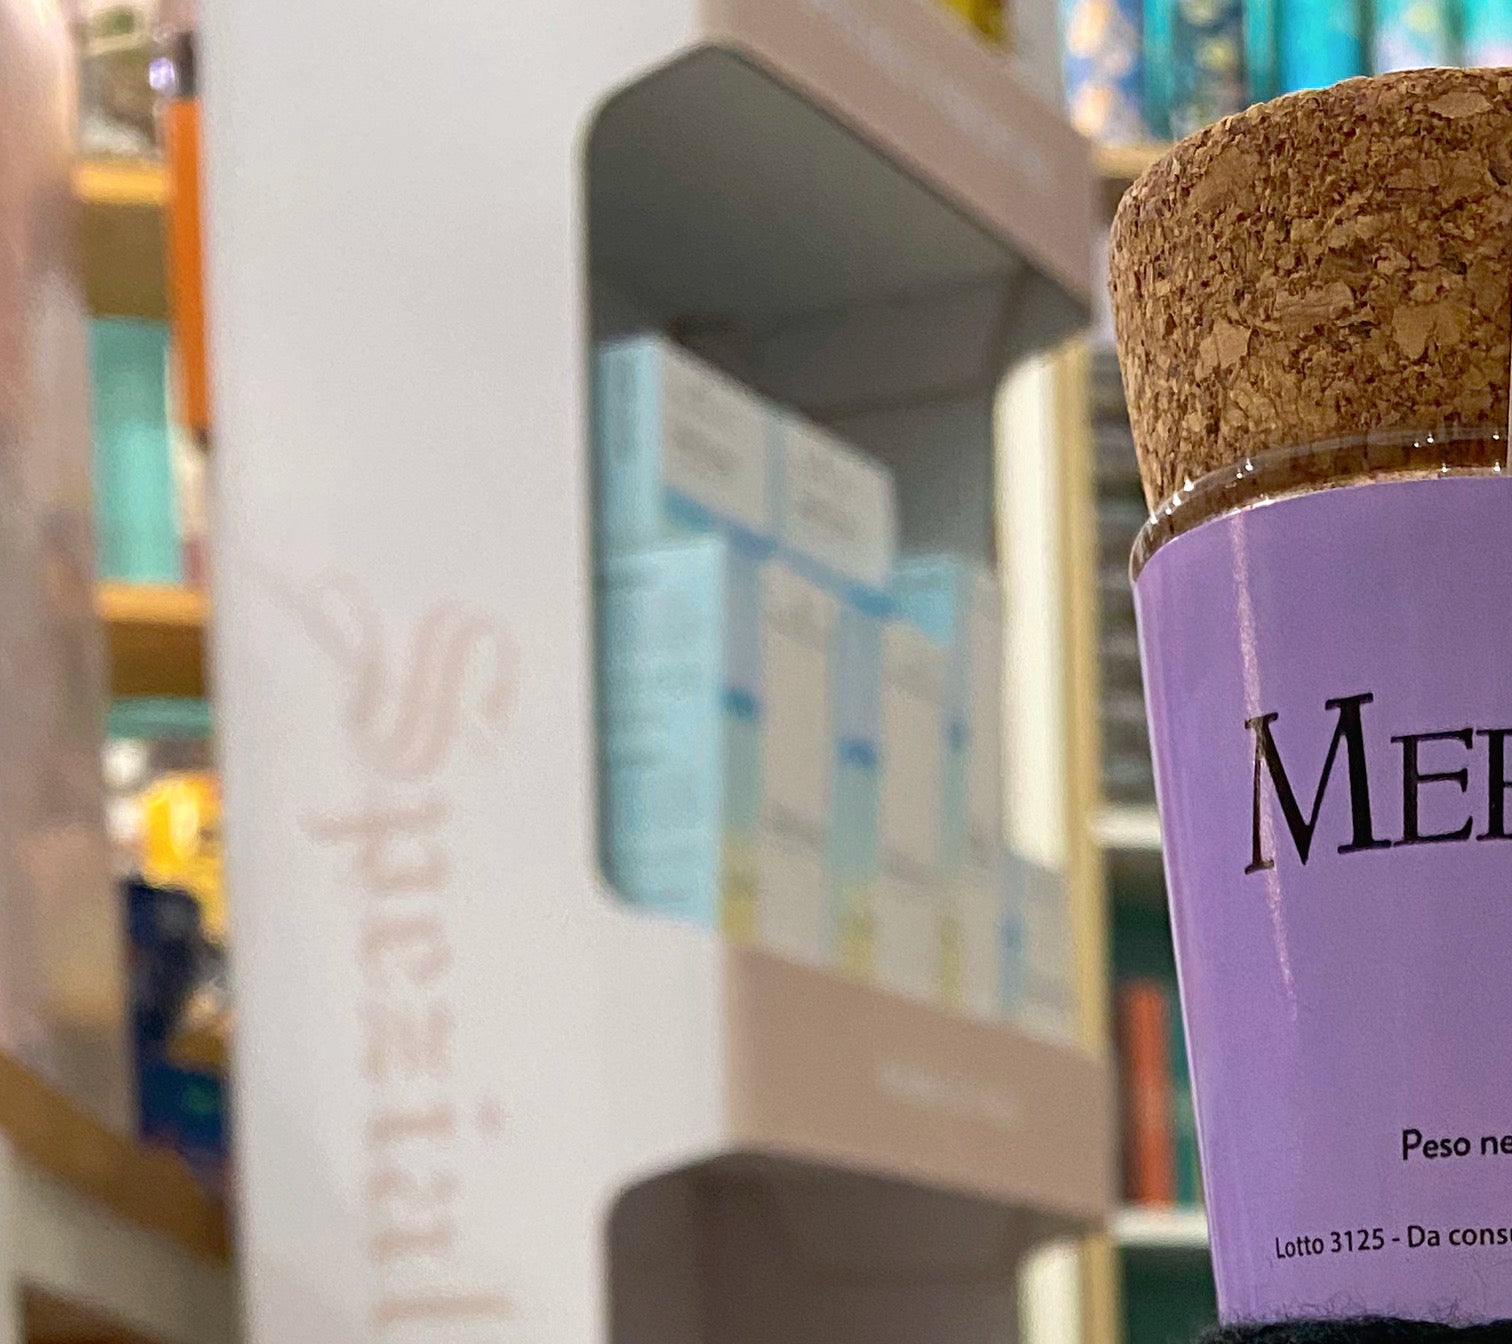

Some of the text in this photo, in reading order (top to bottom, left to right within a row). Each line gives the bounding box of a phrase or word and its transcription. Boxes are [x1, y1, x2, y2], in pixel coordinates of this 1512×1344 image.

[1402, 1128, 1471, 1161] Peso
[1275, 1235, 1325, 1260] Lotto
[1330, 1227, 1385, 1253] 3125
[1407, 1224, 1441, 1249] Da
